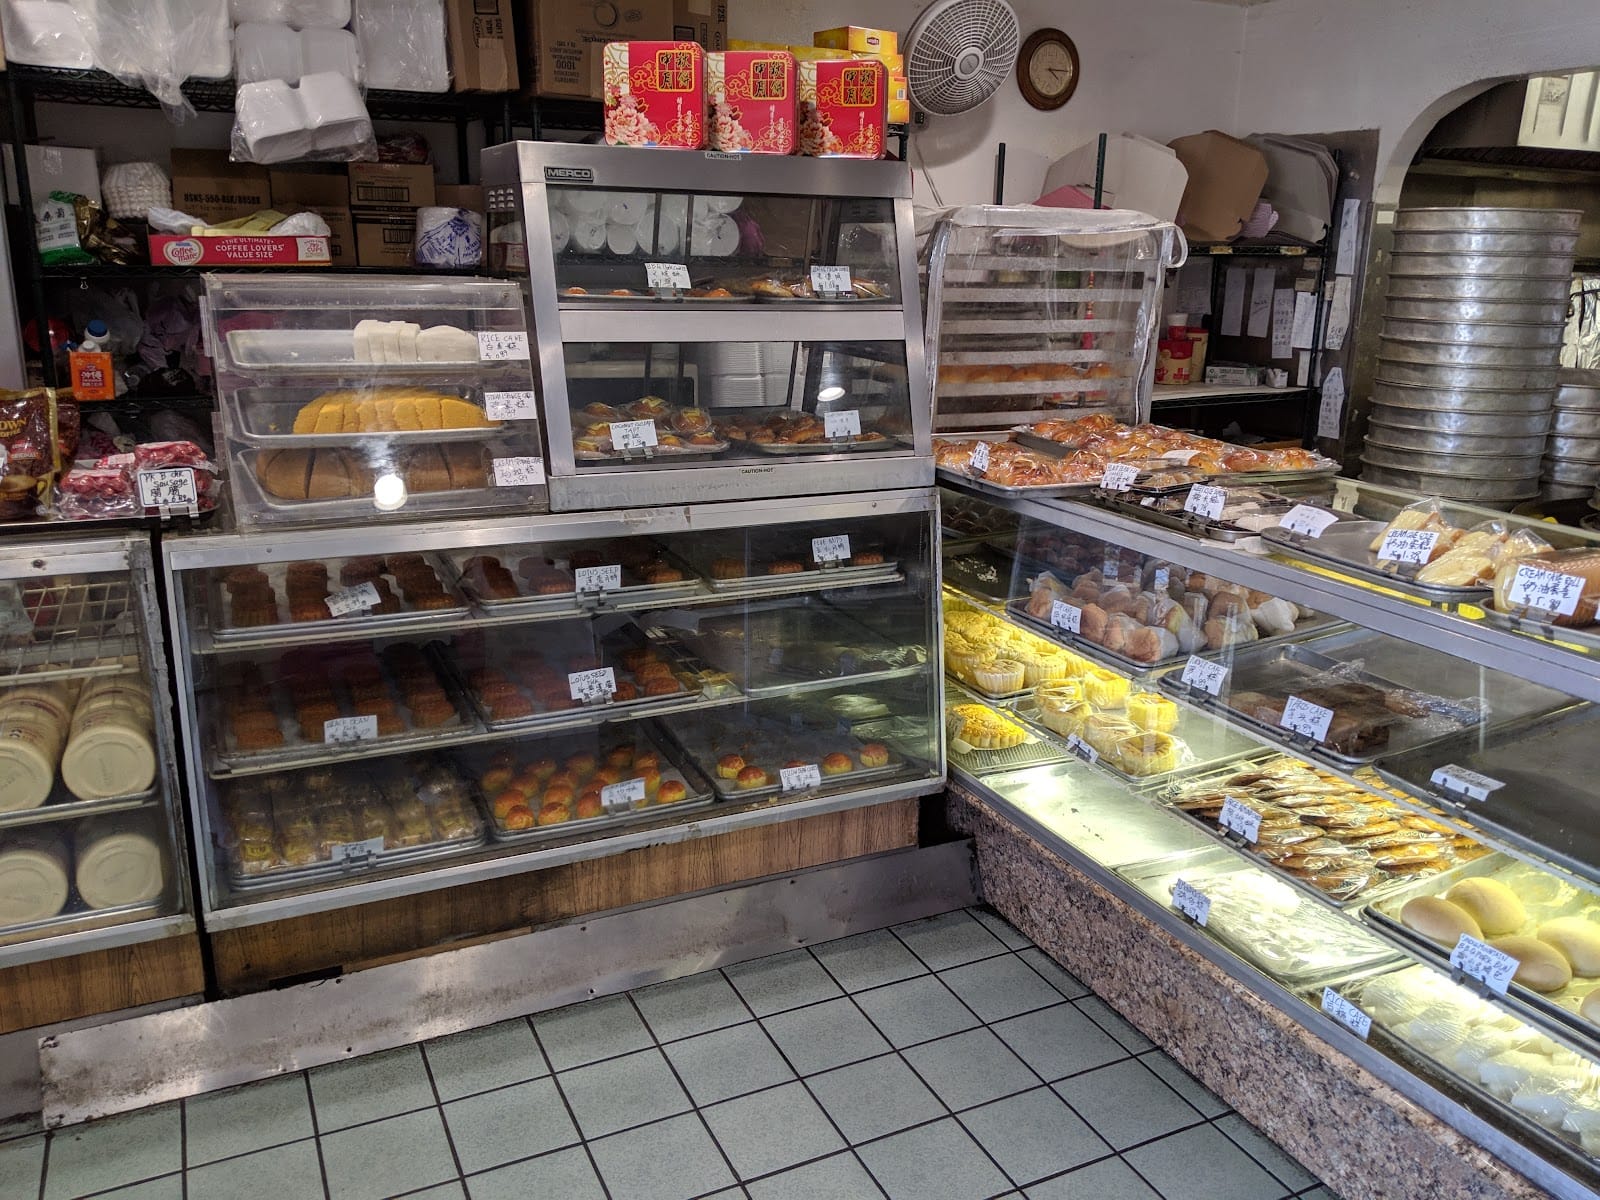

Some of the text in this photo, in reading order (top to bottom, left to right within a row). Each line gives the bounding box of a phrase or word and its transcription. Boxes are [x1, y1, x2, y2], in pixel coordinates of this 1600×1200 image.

[547, 168, 591, 179] MERCO
[171, 246, 195, 257] Coffee
[215, 243, 285, 252] COFFEE LOVERS'
[153, 478, 188, 488] Sausage
[1518, 567, 1546, 579] CREAM
[1309, 705, 1328, 718] CAKE
[1325, 989, 1369, 1028] RICE CAKE
